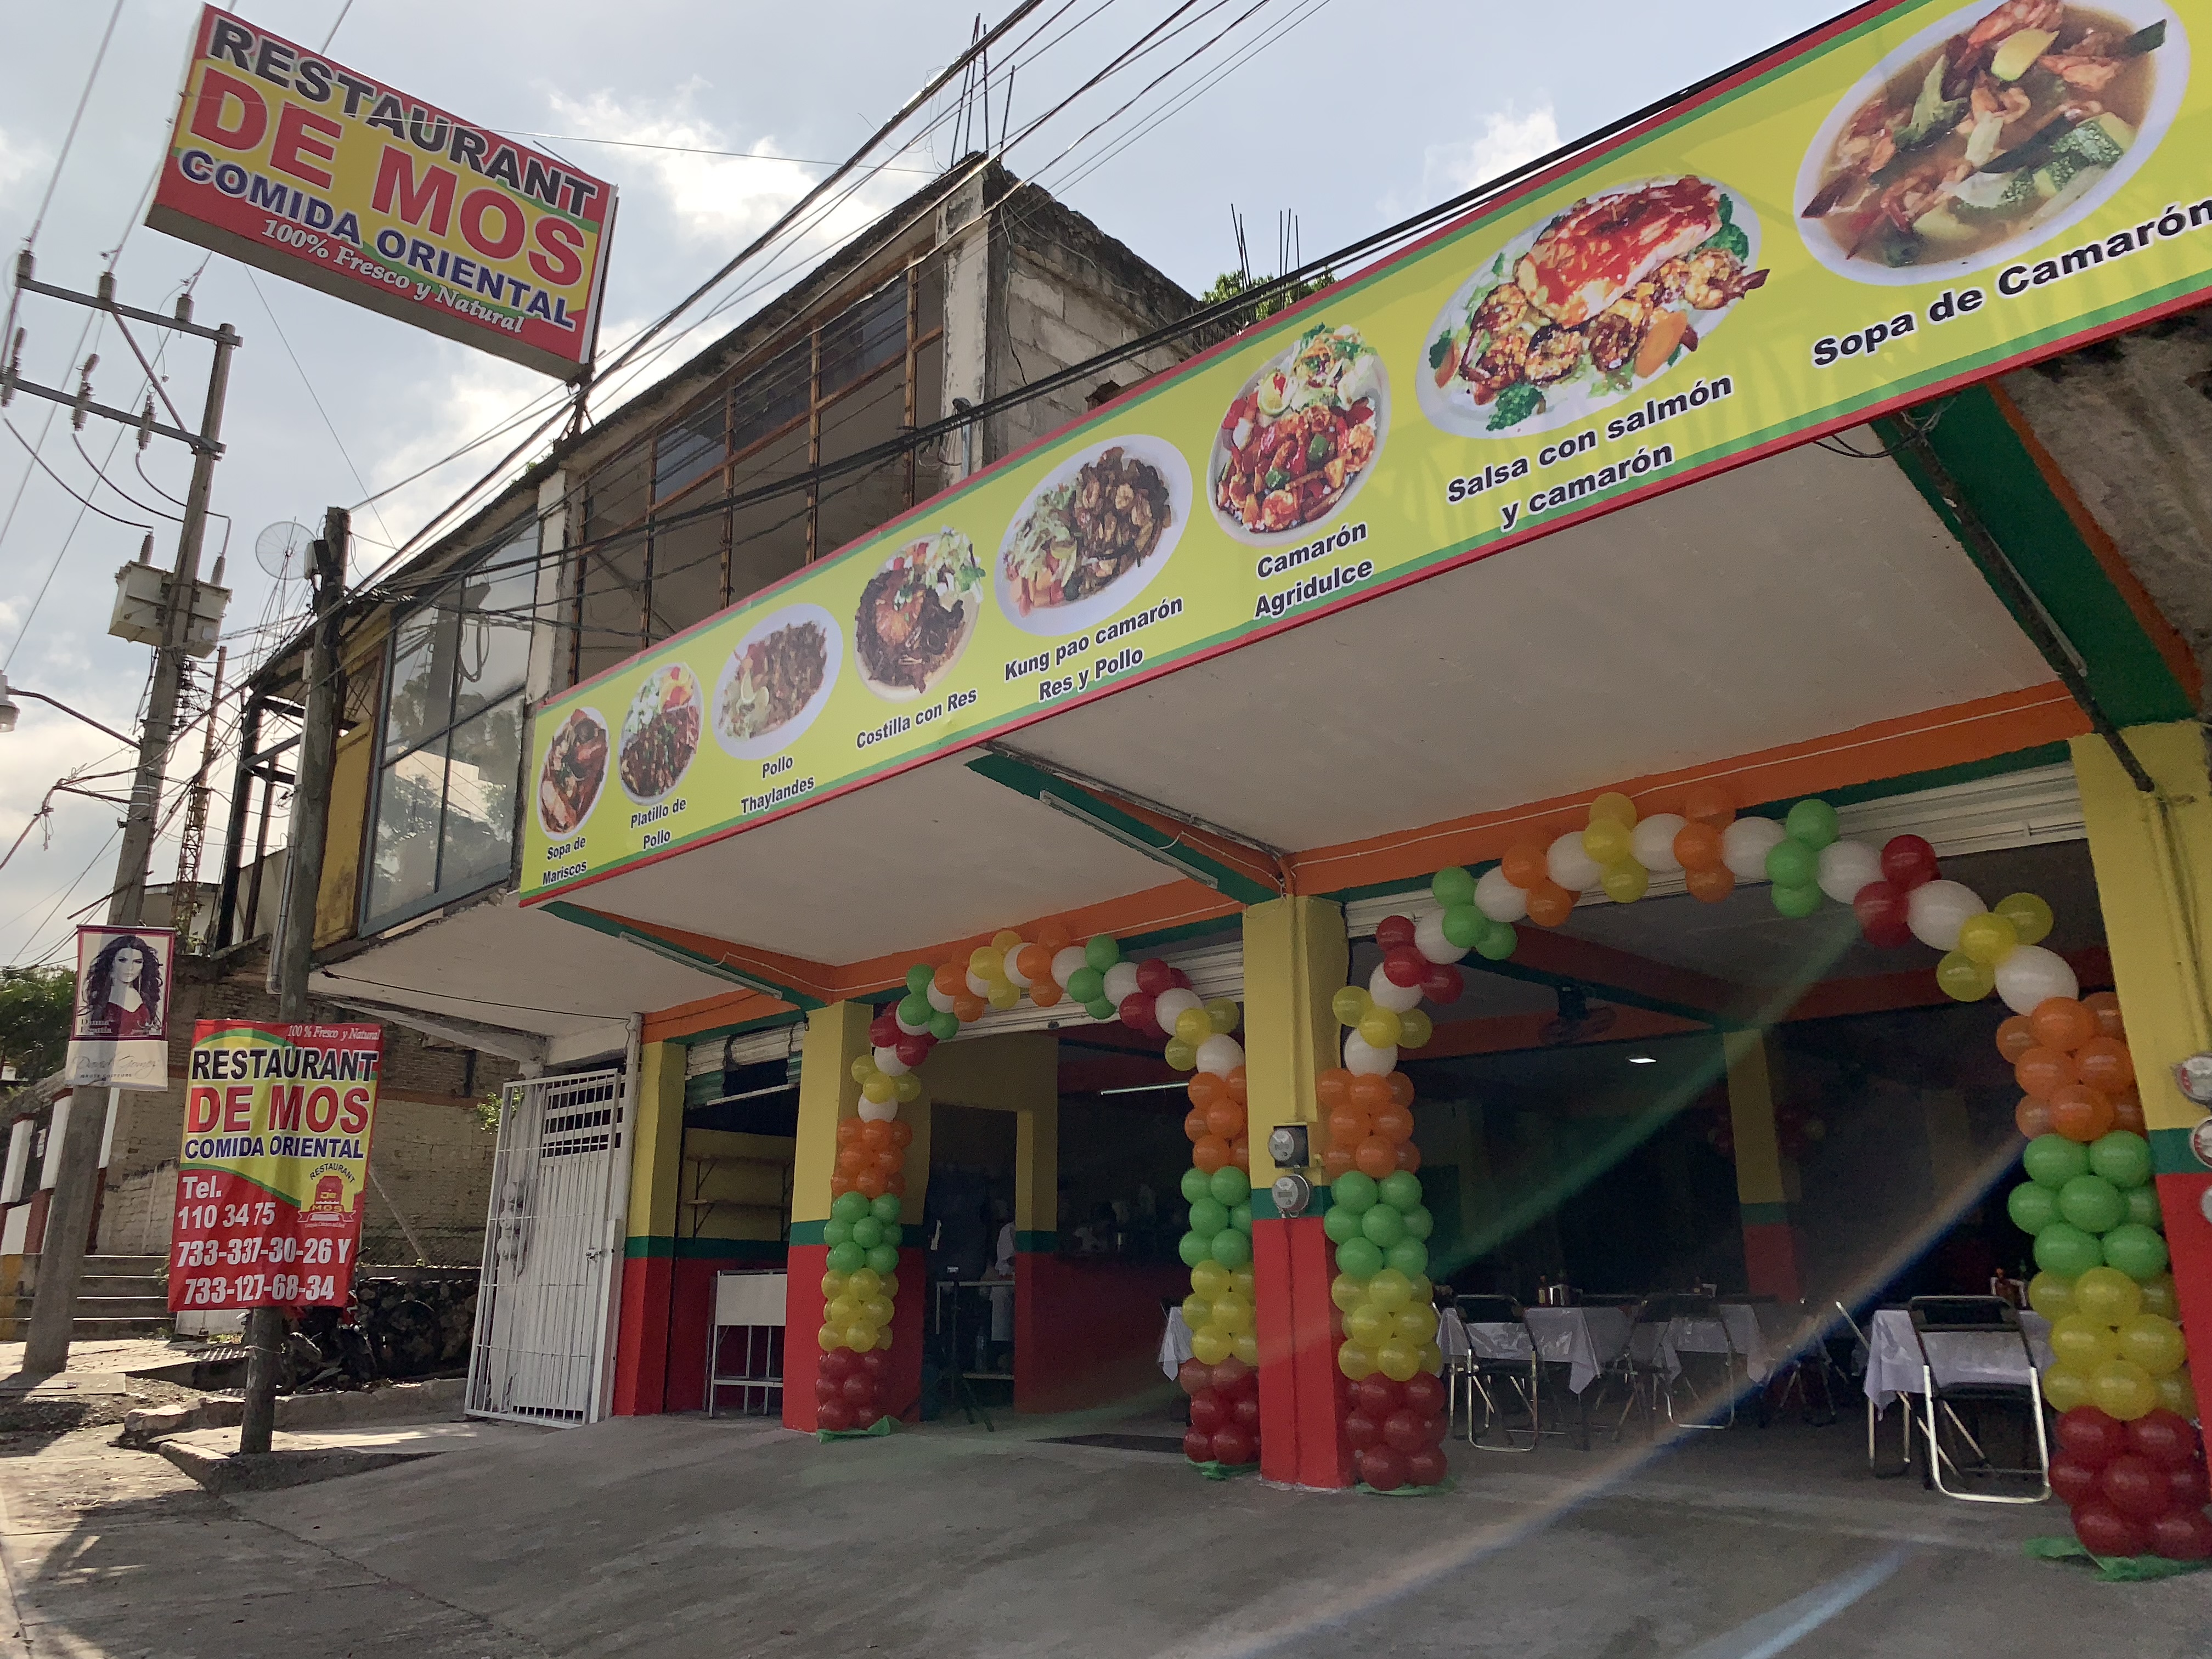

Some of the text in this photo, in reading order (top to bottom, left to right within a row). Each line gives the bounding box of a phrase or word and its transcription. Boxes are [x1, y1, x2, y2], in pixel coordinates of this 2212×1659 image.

[210, 18, 597, 216] RESTAURANT
[190, 67, 586, 286] DE MOS
[182, 150, 576, 331] COMIDA ORIENTAL
[263, 219, 524, 334] 100% Fresco y Natural
[1814, 199, 2212, 366] Sopa de Camarón
[1448, 375, 1733, 503] Salsa con salmón
[1500, 443, 1673, 529] y camarón
[1257, 522, 1367, 579] Camarón
[1254, 558, 1373, 618] Agridulce
[1005, 597, 1182, 681] Kung pao camarón
[1040, 647, 1143, 701] Res y Pollo
[856, 687, 977, 749] Costilla con Res
[762, 755, 793, 778] Pollo
[631, 798, 686, 828] Platillo de
[741, 776, 814, 815] Thaylandes
[547, 837, 586, 860] Sopa de
[644, 830, 671, 850] Pollo
[543, 860, 587, 885] Mariscos
[288, 1025, 381, 1041] 100 % Fresco y Natural
[192, 1048, 378, 1081] RESTAURANT
[188, 1085, 370, 1134] DE MOS
[185, 1135, 364, 1159] COMIDA ORIENTAL
[182, 1176, 222, 1199] Tel.
[310, 1163, 356, 1183] RESTAURANT
[178, 1202, 276, 1229] 110 34 75
[177, 1237, 352, 1267] 733-337-30-26 Y
[184, 1274, 335, 1305] 733-127-68-34
